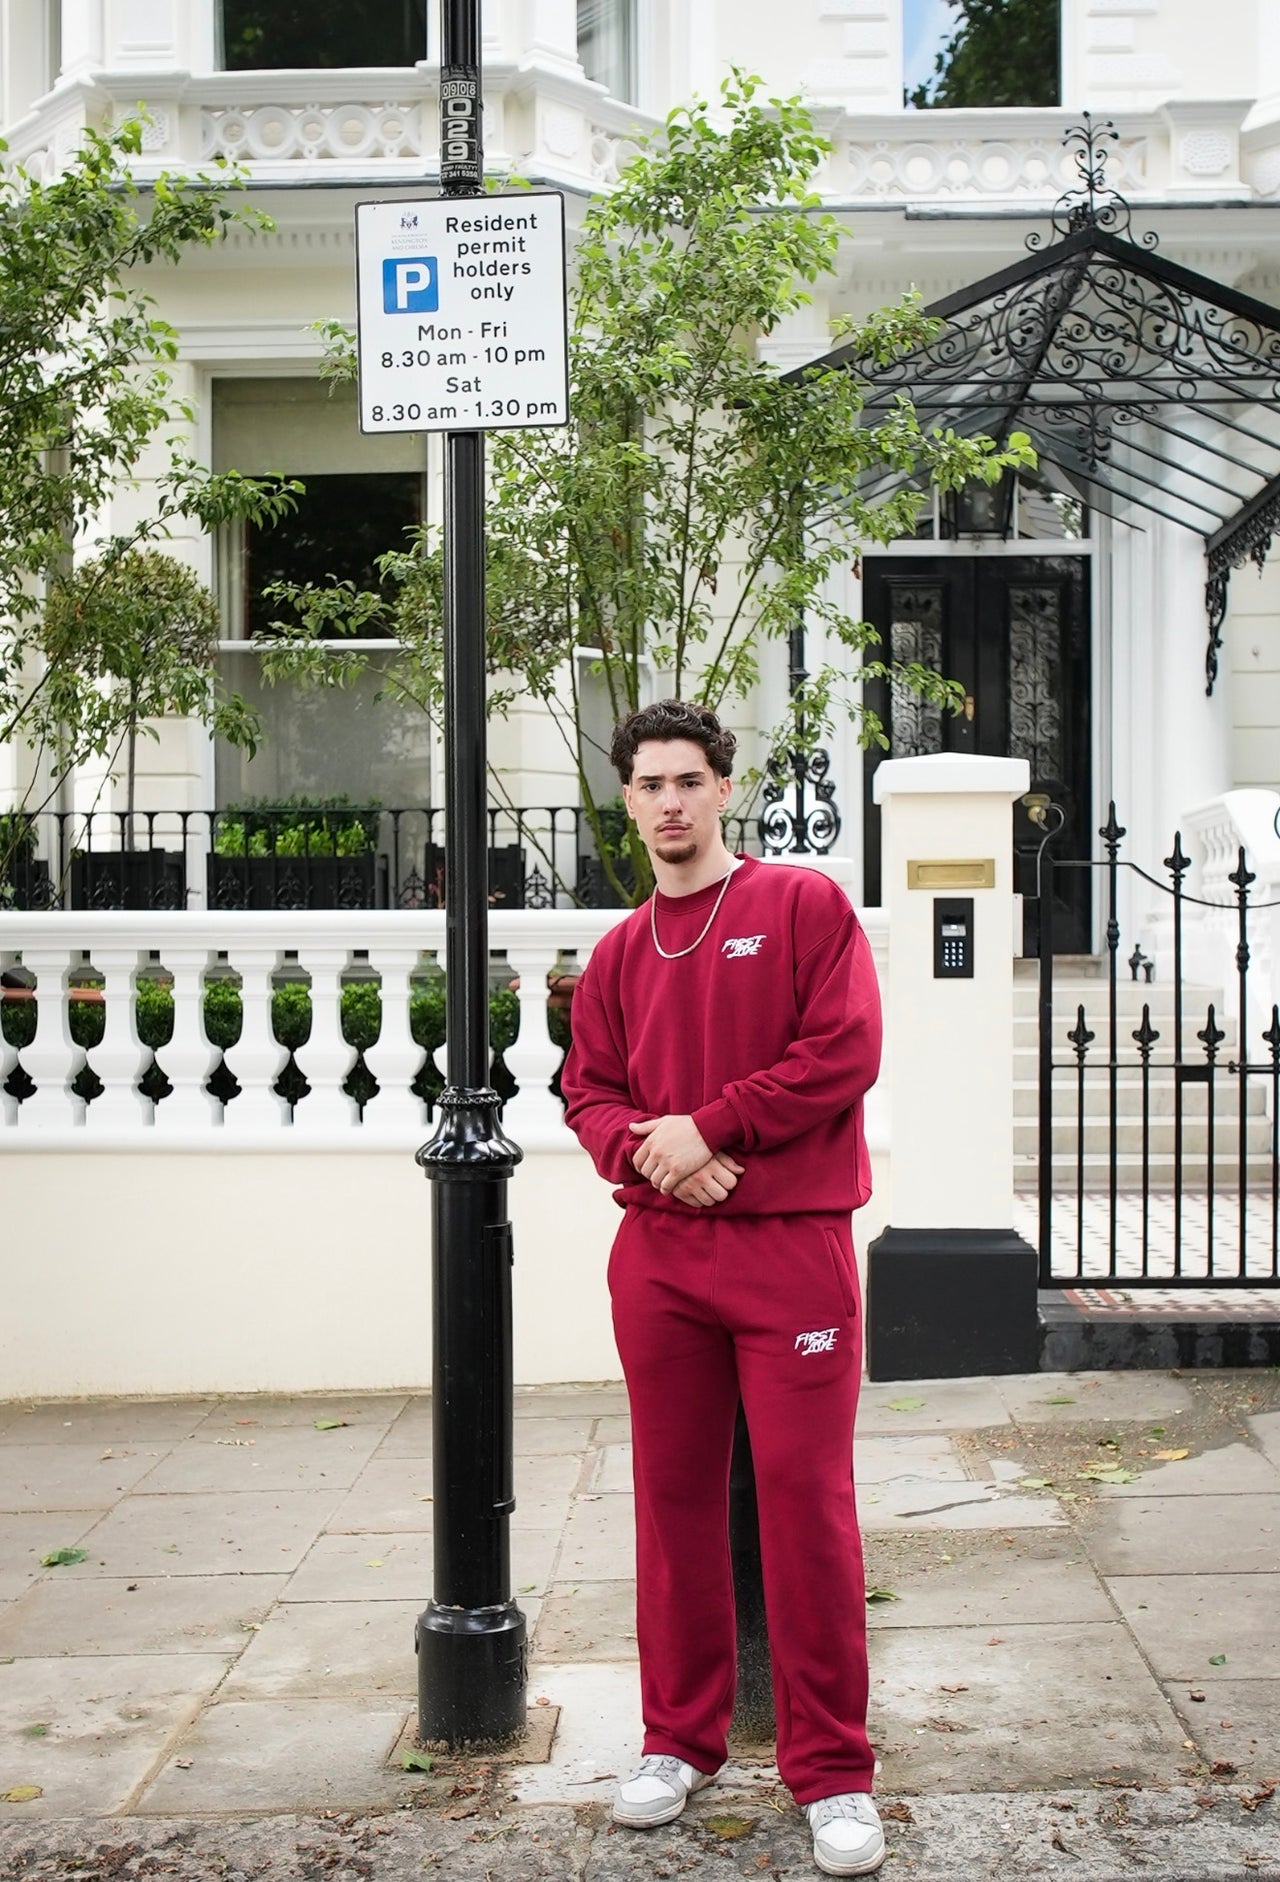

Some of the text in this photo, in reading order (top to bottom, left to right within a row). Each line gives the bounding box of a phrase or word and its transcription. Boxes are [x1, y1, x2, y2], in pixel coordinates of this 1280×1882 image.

[442, 83, 476, 97] 0908
[446, 213, 538, 233] Resident
[457, 236, 526, 258] permit
[453, 259, 532, 278] holders
[396, 263, 431, 309] P
[470, 282, 515, 301] only
[418, 324, 462, 341] Mon
[481, 321, 507, 338] Fri
[381, 350, 431, 368] 8.30
[436, 353, 467, 365] am
[484, 346, 508, 363] 10
[514, 348, 545, 365] pm
[446, 376, 482, 393] Sat
[372, 404, 421, 422] 8.30
[427, 407, 457, 419] am
[475, 399, 521, 417] 1.30
[526, 401, 557, 418] pm
[721, 934, 767, 952] FIRST
[794, 1328, 840, 1350] FIRST
